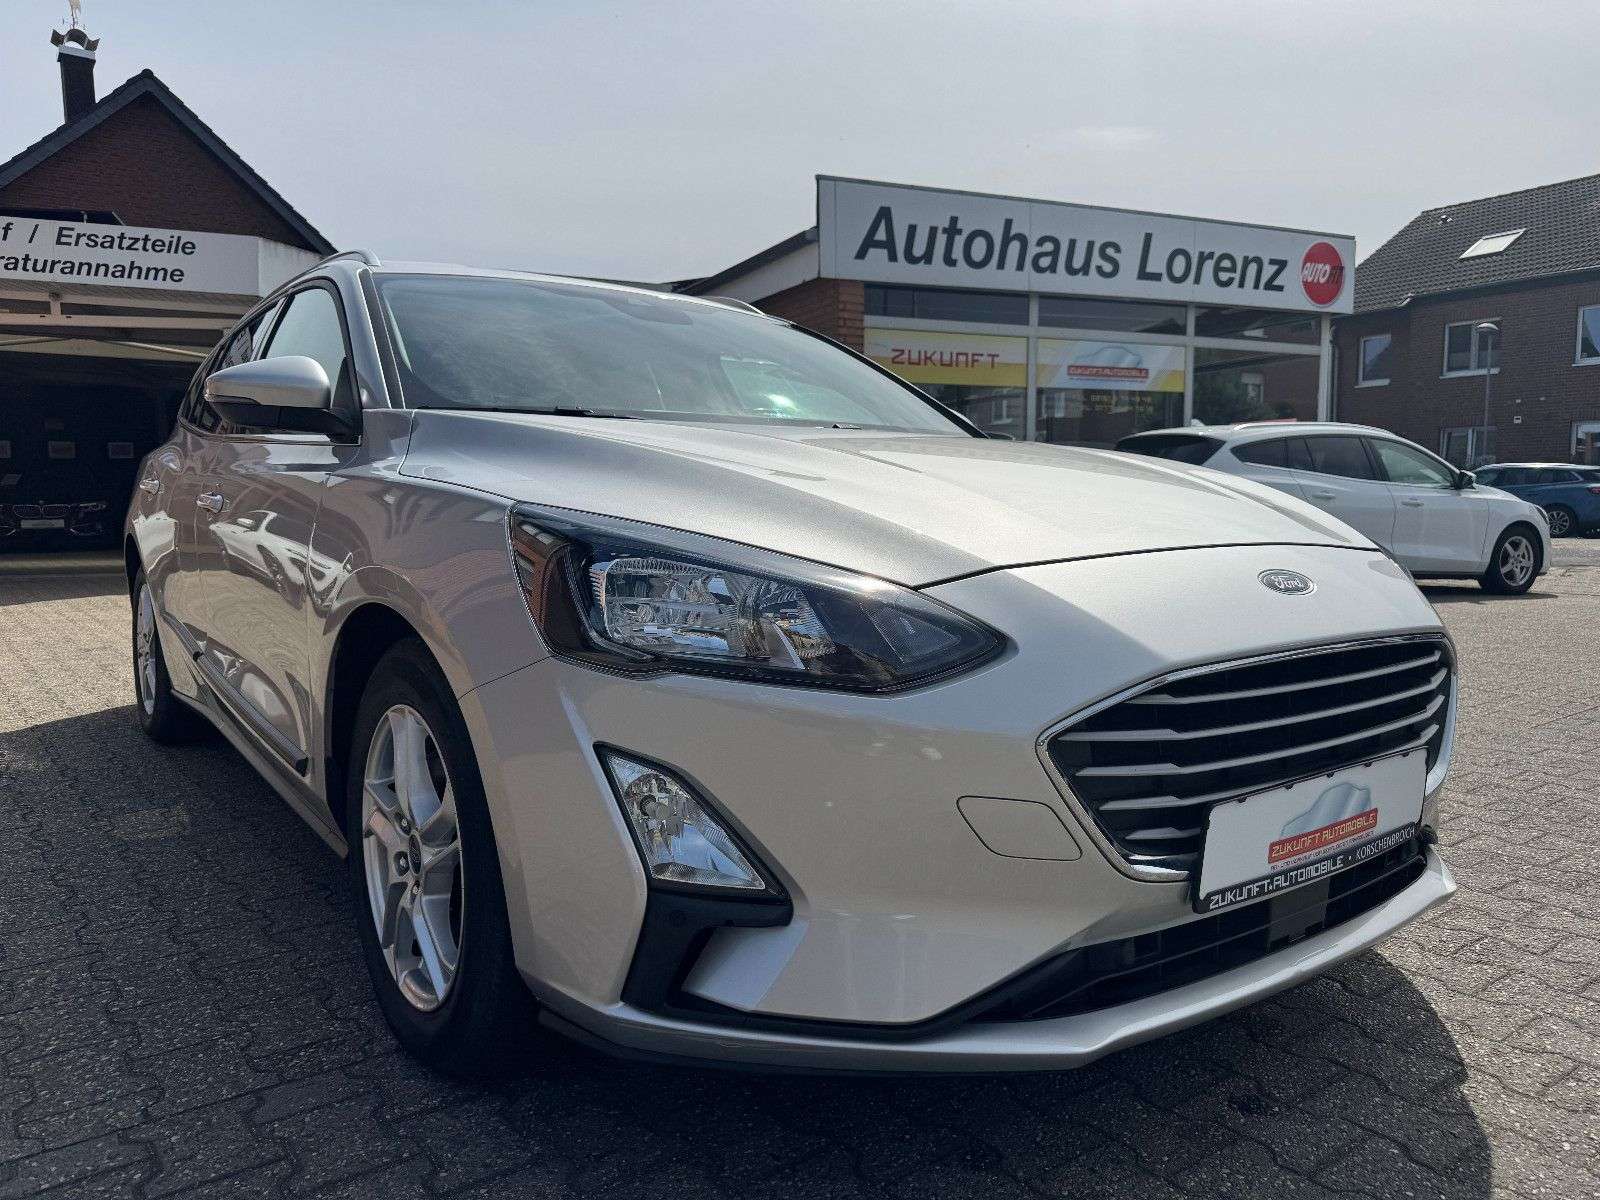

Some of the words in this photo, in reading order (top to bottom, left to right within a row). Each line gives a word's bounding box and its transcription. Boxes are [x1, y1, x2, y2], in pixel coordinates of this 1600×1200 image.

[56, 226, 196, 255] Ersatzteile
[855, 206, 1122, 280] Autohaus
[1136, 231, 1288, 293] Lorenz
[891, 348, 999, 369] ZUKUNFT
[1270, 575, 1305, 589] Ford
[1356, 827, 1416, 860] KORSCHENBROICH
